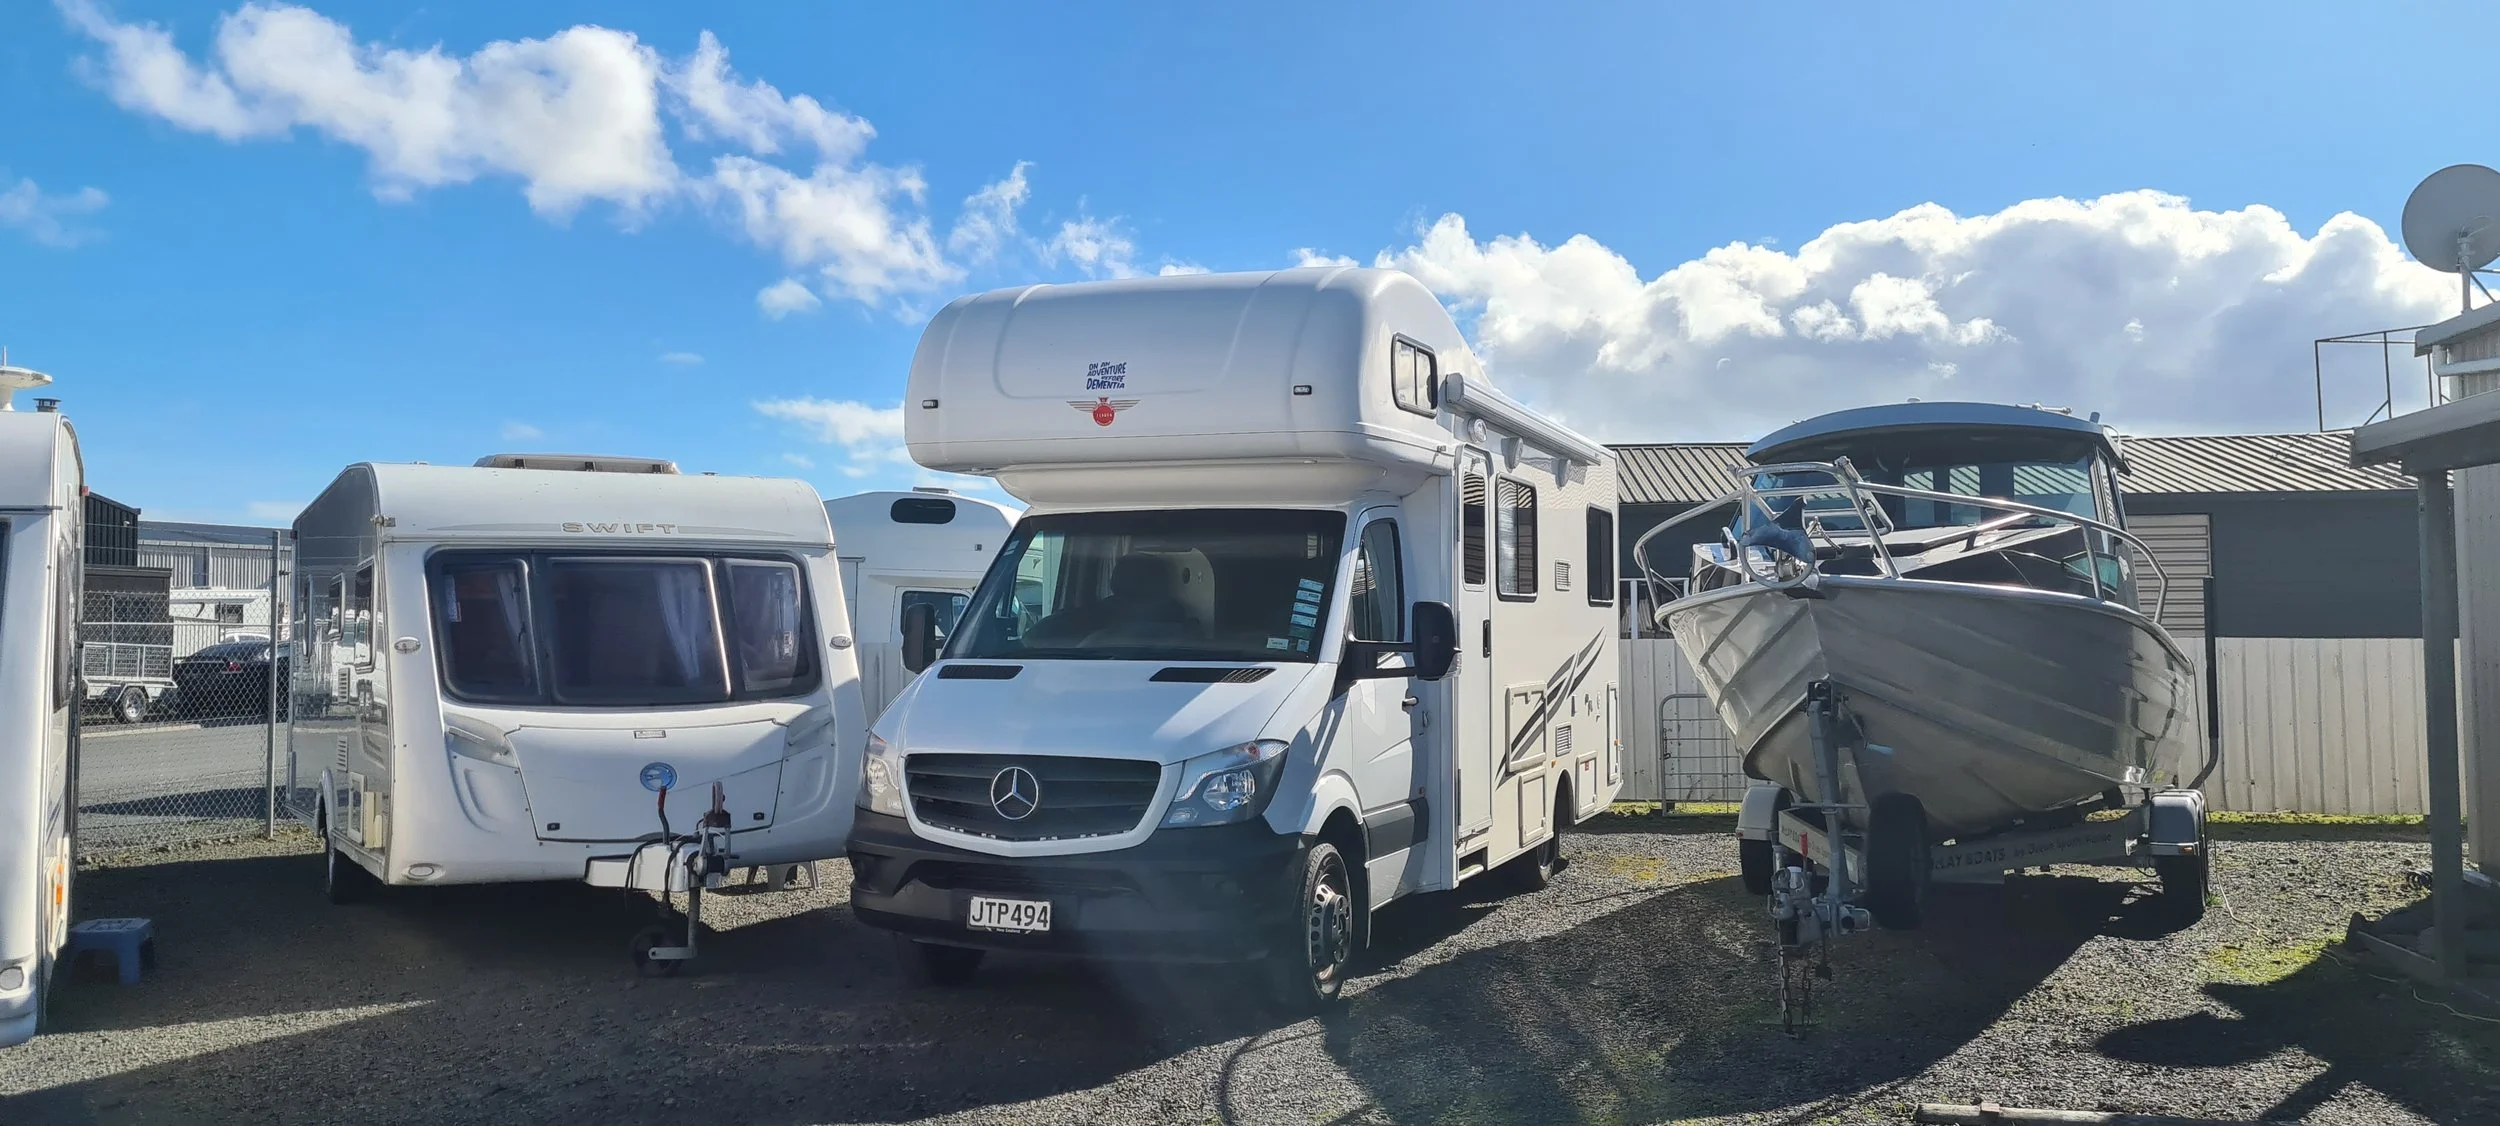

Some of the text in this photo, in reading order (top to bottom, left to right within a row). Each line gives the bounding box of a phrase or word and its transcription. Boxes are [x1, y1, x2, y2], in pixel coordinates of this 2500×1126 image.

[1087, 362, 1126, 376] ADVENTURE
[1088, 362, 1099, 371] ON
[1087, 378, 1125, 390] DEMENTIA
[562, 522, 676, 534] SWIFT
[972, 901, 1048, 928] JTP494
